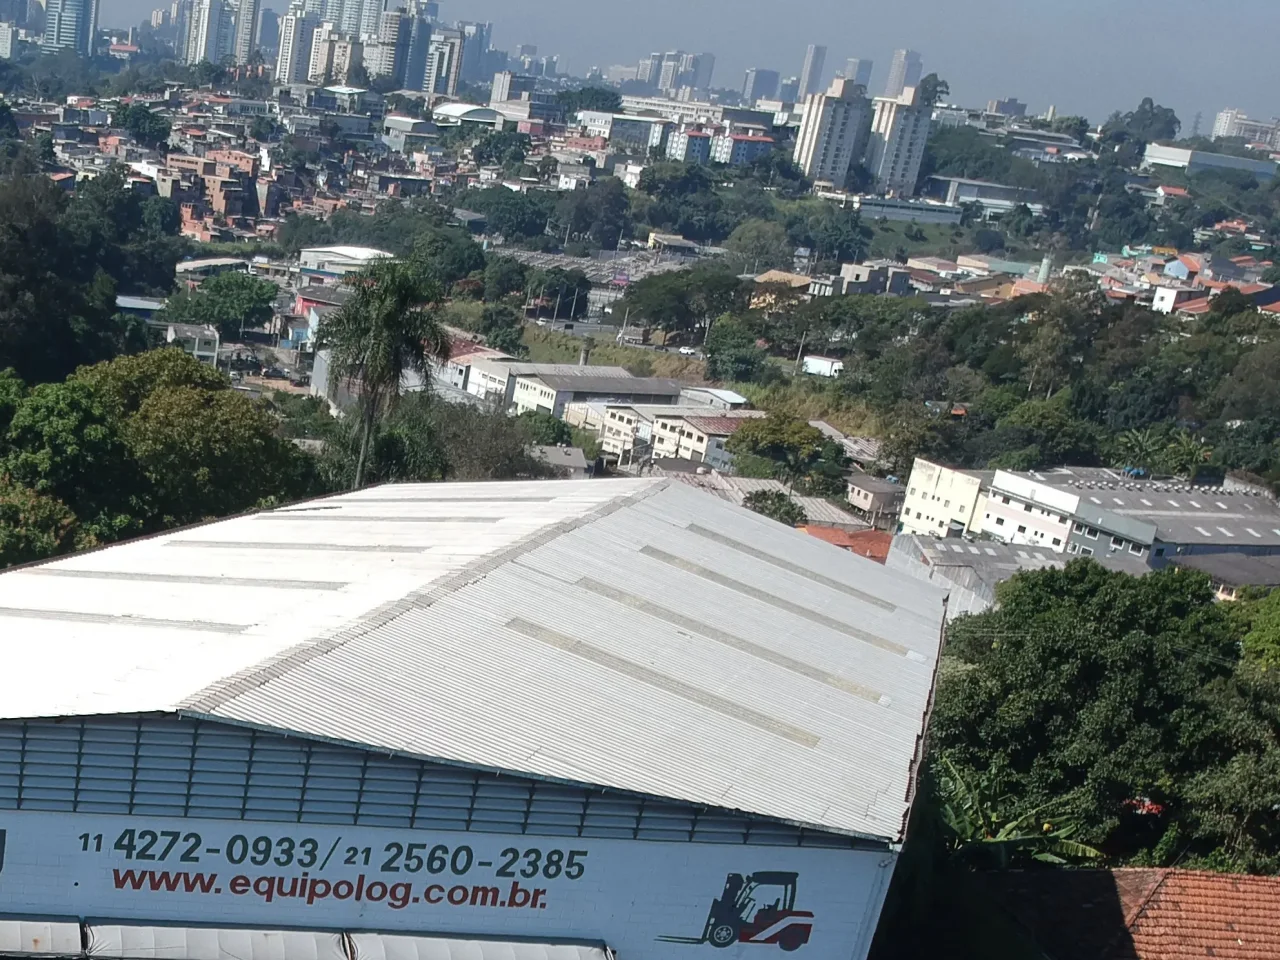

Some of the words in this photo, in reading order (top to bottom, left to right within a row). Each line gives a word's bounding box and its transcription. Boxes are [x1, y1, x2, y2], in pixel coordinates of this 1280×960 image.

[78, 832, 103, 852] 11
[344, 846, 372, 866] 21
[380, 841, 588, 880] 2560-2385
